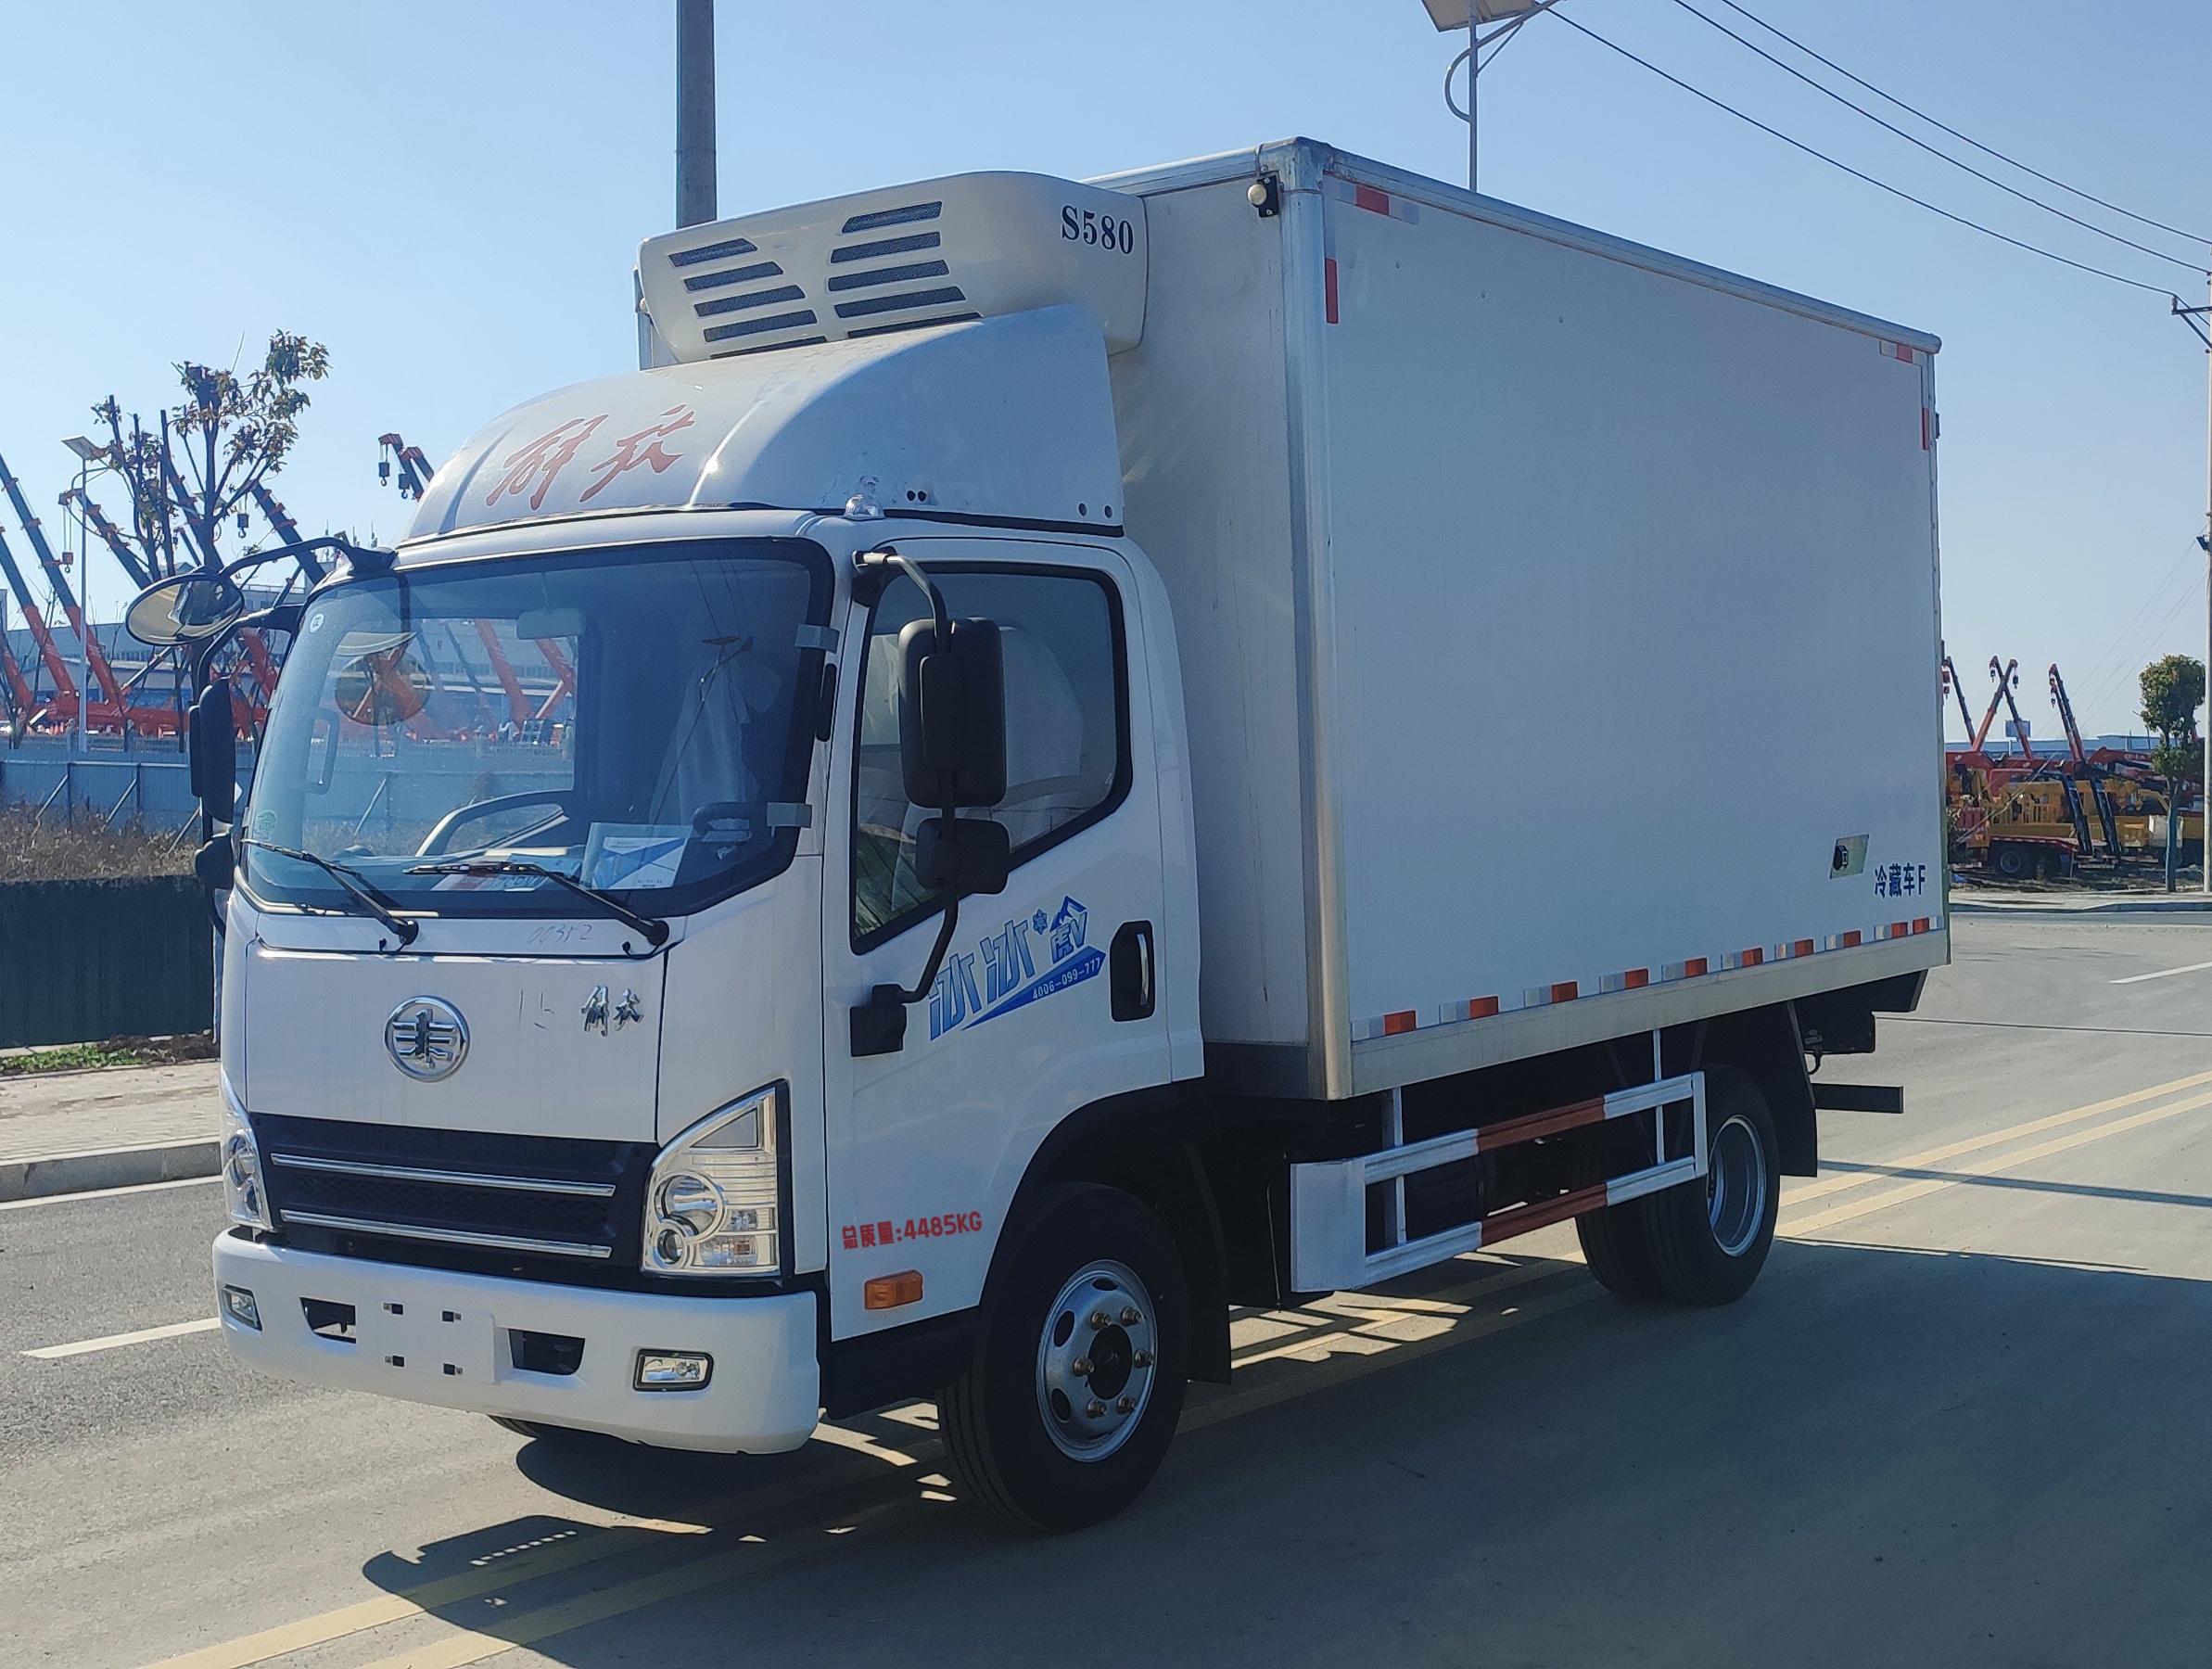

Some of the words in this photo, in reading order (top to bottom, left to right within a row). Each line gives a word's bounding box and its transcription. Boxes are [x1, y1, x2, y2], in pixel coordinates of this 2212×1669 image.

[1061, 204, 1134, 255] S580
[1032, 956, 1101, 1000] 4006-099-777
[842, 1211, 983, 1250] 总质量:4485KG
